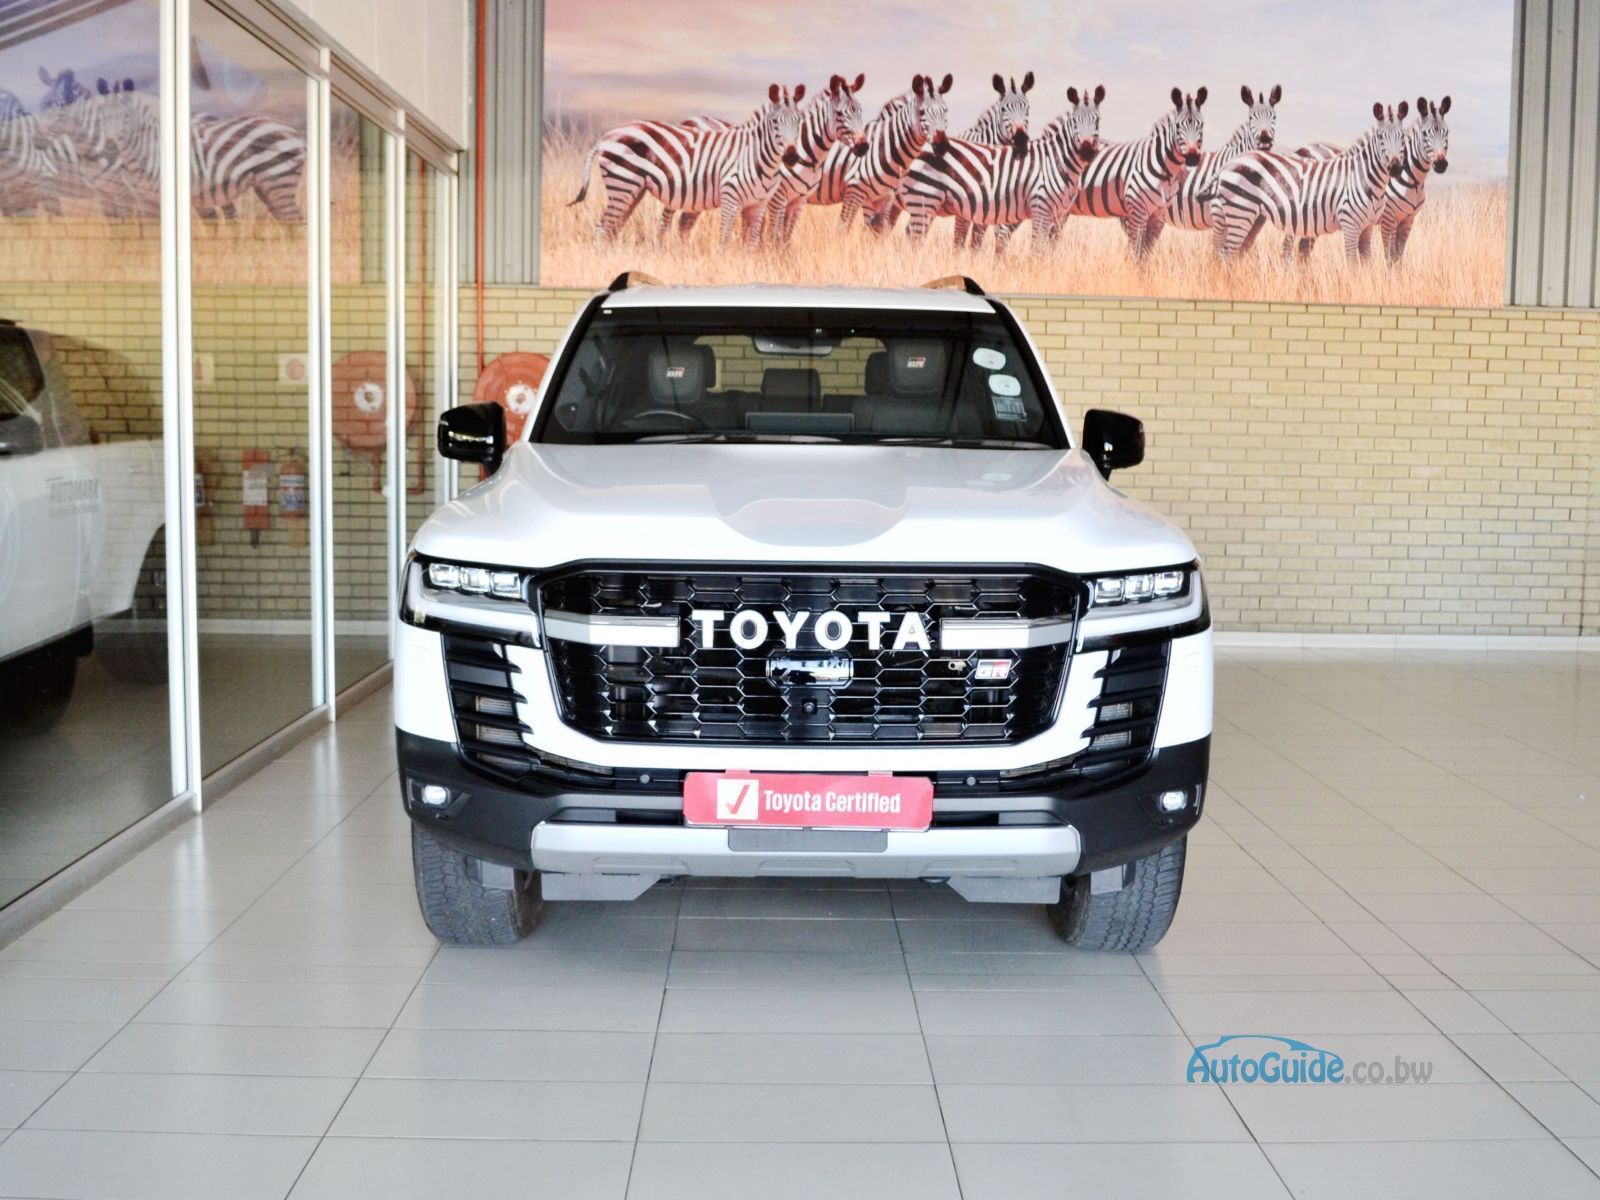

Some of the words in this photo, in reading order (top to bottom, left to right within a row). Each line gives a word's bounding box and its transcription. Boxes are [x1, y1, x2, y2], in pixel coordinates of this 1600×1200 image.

[692, 609, 931, 650] TOYOTA
[975, 661, 1010, 679] GR
[764, 790, 821, 813] Toyota
[826, 791, 901, 813] Certified
